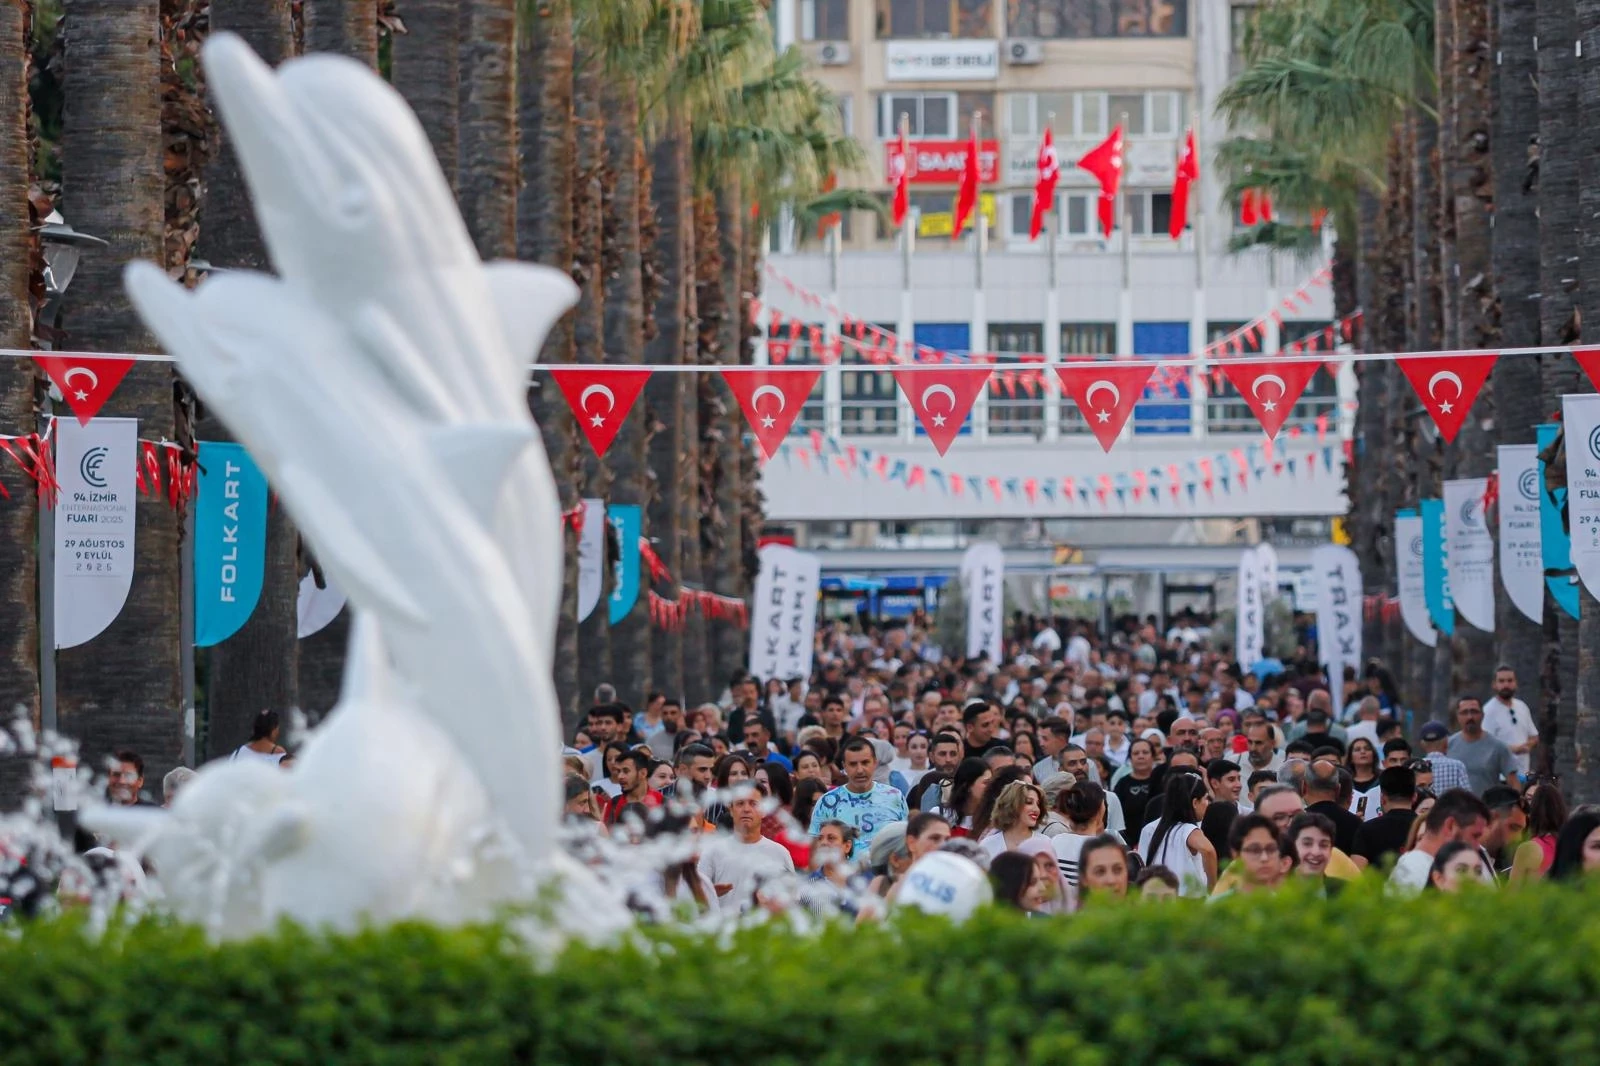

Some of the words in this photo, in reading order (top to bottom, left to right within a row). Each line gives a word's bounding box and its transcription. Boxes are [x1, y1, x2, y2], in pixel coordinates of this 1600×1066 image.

[918, 151, 996, 171] SAAT
[67, 514, 98, 523] FUARI
[100, 515, 124, 524] 2025
[1580, 516, 1591, 524] 29
[220, 461, 241, 603] FOLKART
[64, 539, 76, 548] 29
[78, 537, 125, 548] AĞUSTOS
[84, 550, 113, 559] EYLÜL
